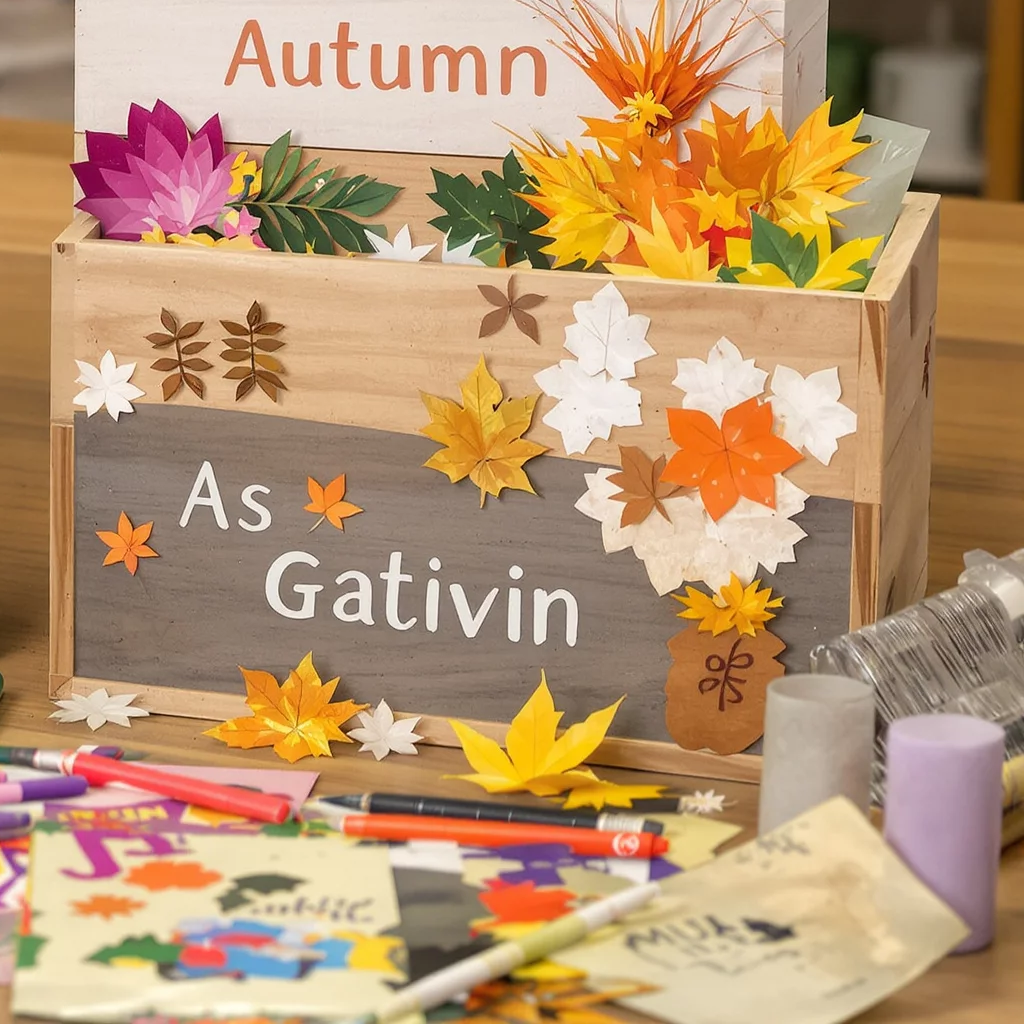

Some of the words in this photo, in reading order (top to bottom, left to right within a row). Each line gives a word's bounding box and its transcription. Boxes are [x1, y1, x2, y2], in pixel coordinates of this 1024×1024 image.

[224, 19, 547, 96] Autumn
[179, 460, 272, 532] As
[265, 551, 579, 647] Gativin
